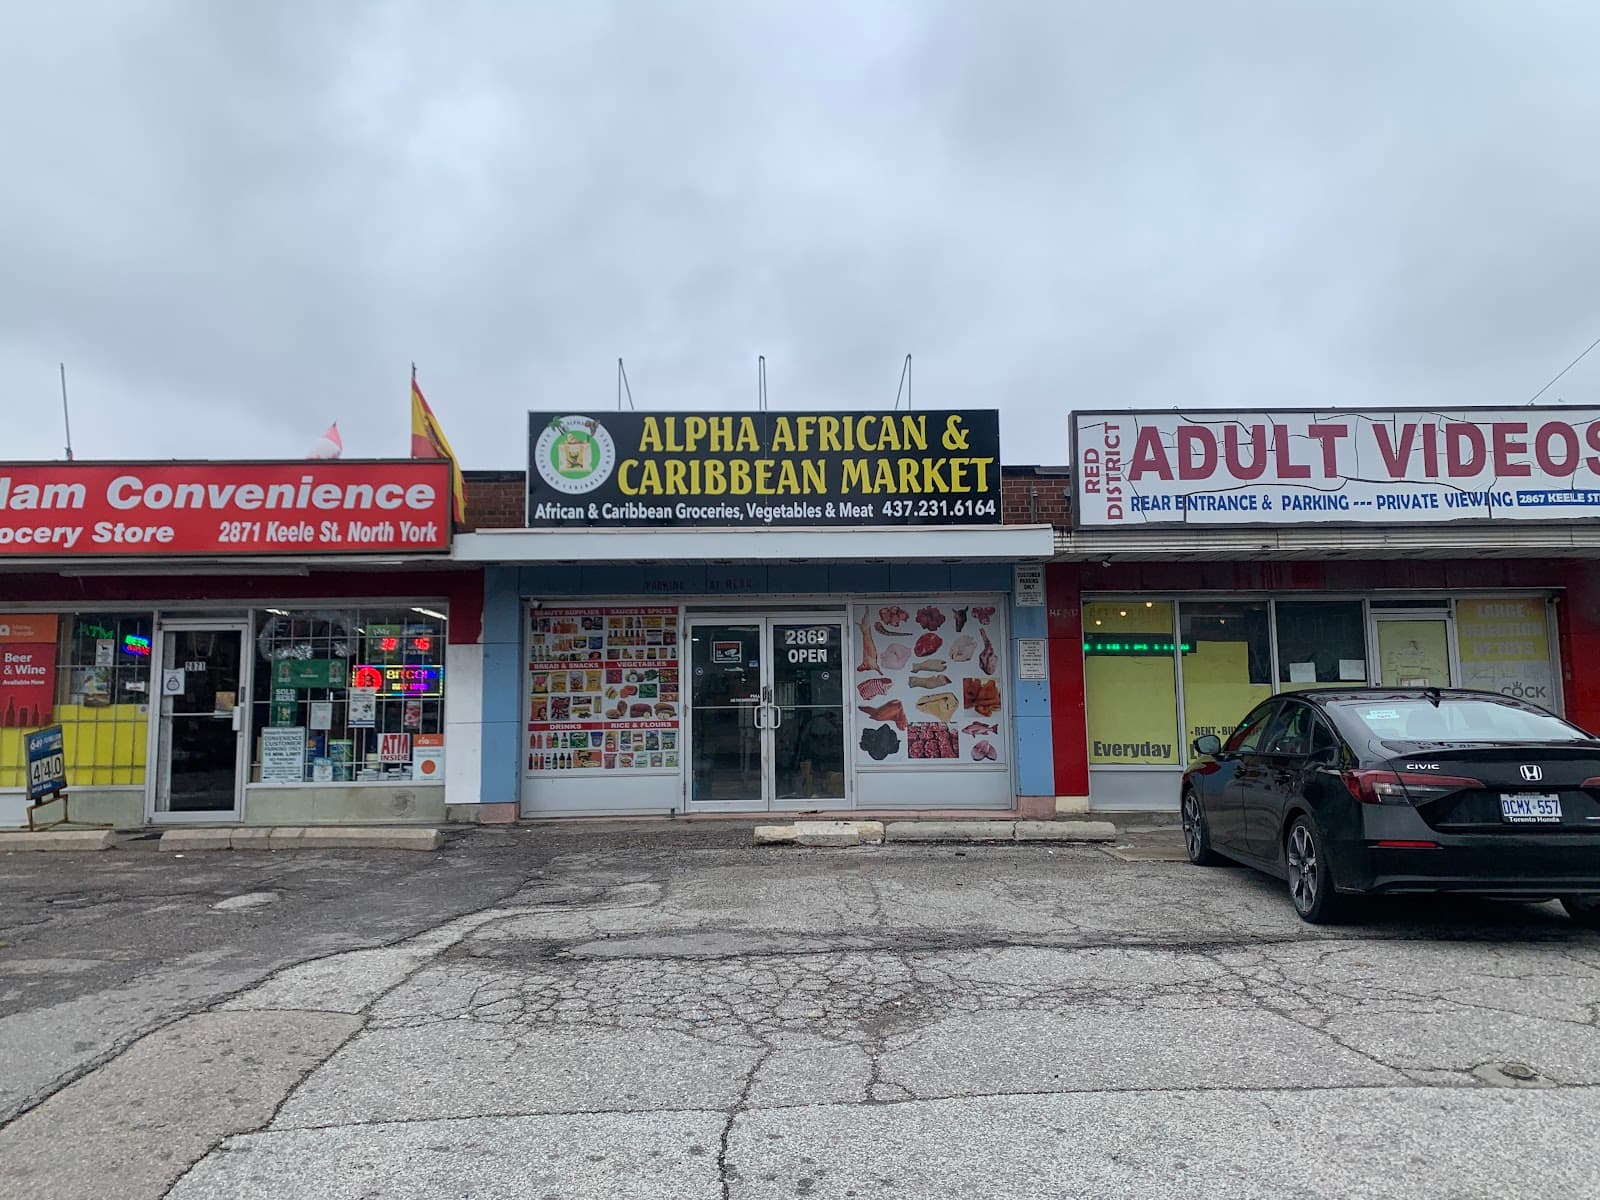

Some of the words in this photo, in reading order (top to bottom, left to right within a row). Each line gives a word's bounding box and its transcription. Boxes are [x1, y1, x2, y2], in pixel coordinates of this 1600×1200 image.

[639, 416, 760, 452] ALPHA
[771, 415, 929, 451] AFRICAN
[941, 415, 970, 450] &
[1128, 424, 1348, 481] ADULT
[617, 458, 827, 496] CARIBBEAN
[841, 456, 994, 494] MARKET
[1084, 447, 1101, 494] RED
[1104, 421, 1124, 520] DISTRICT
[0, 477, 86, 510] lam
[106, 475, 436, 511] Convenience
[1130, 495, 1170, 512] REAR
[1175, 494, 1258, 511] ENTRANCE
[1262, 494, 1273, 511] &
[1282, 493, 1349, 511] PARKING
[1376, 492, 1439, 510] PRIVATE
[1444, 491, 1513, 508] VIEWING
[1519, 494, 1545, 505] 2867
[1548, 492, 1584, 504] KEELE
[534, 502, 585, 520] African
[588, 502, 599, 519] &
[602, 502, 672, 520] Caribbean
[675, 502, 744, 521] Groceries,
[746, 502, 822, 523] Vegetables
[825, 502, 836, 518] &
[839, 502, 873, 518] Meat
[882, 499, 996, 518] 437.231.6164
[0, 525, 83, 548] ocery
[92, 521, 175, 543] Store
[218, 521, 261, 542] 2871
[266, 520, 314, 542] Keele
[319, 519, 342, 542] St.
[347, 520, 394, 543] North
[400, 521, 437, 542] York
[1478, 605, 1527, 618] LARGE
[785, 629, 829, 645] 2869
[1462, 622, 1543, 637] SELECTION
[4, 652, 33, 663] Beer
[788, 648, 828, 664] OPEN
[3, 664, 13, 675] &
[15, 664, 47, 675] Wine
[640, 721, 672, 729] FLOURS
[1194, 726, 1216, 736] RENT
[1093, 740, 1172, 759] Everyday
